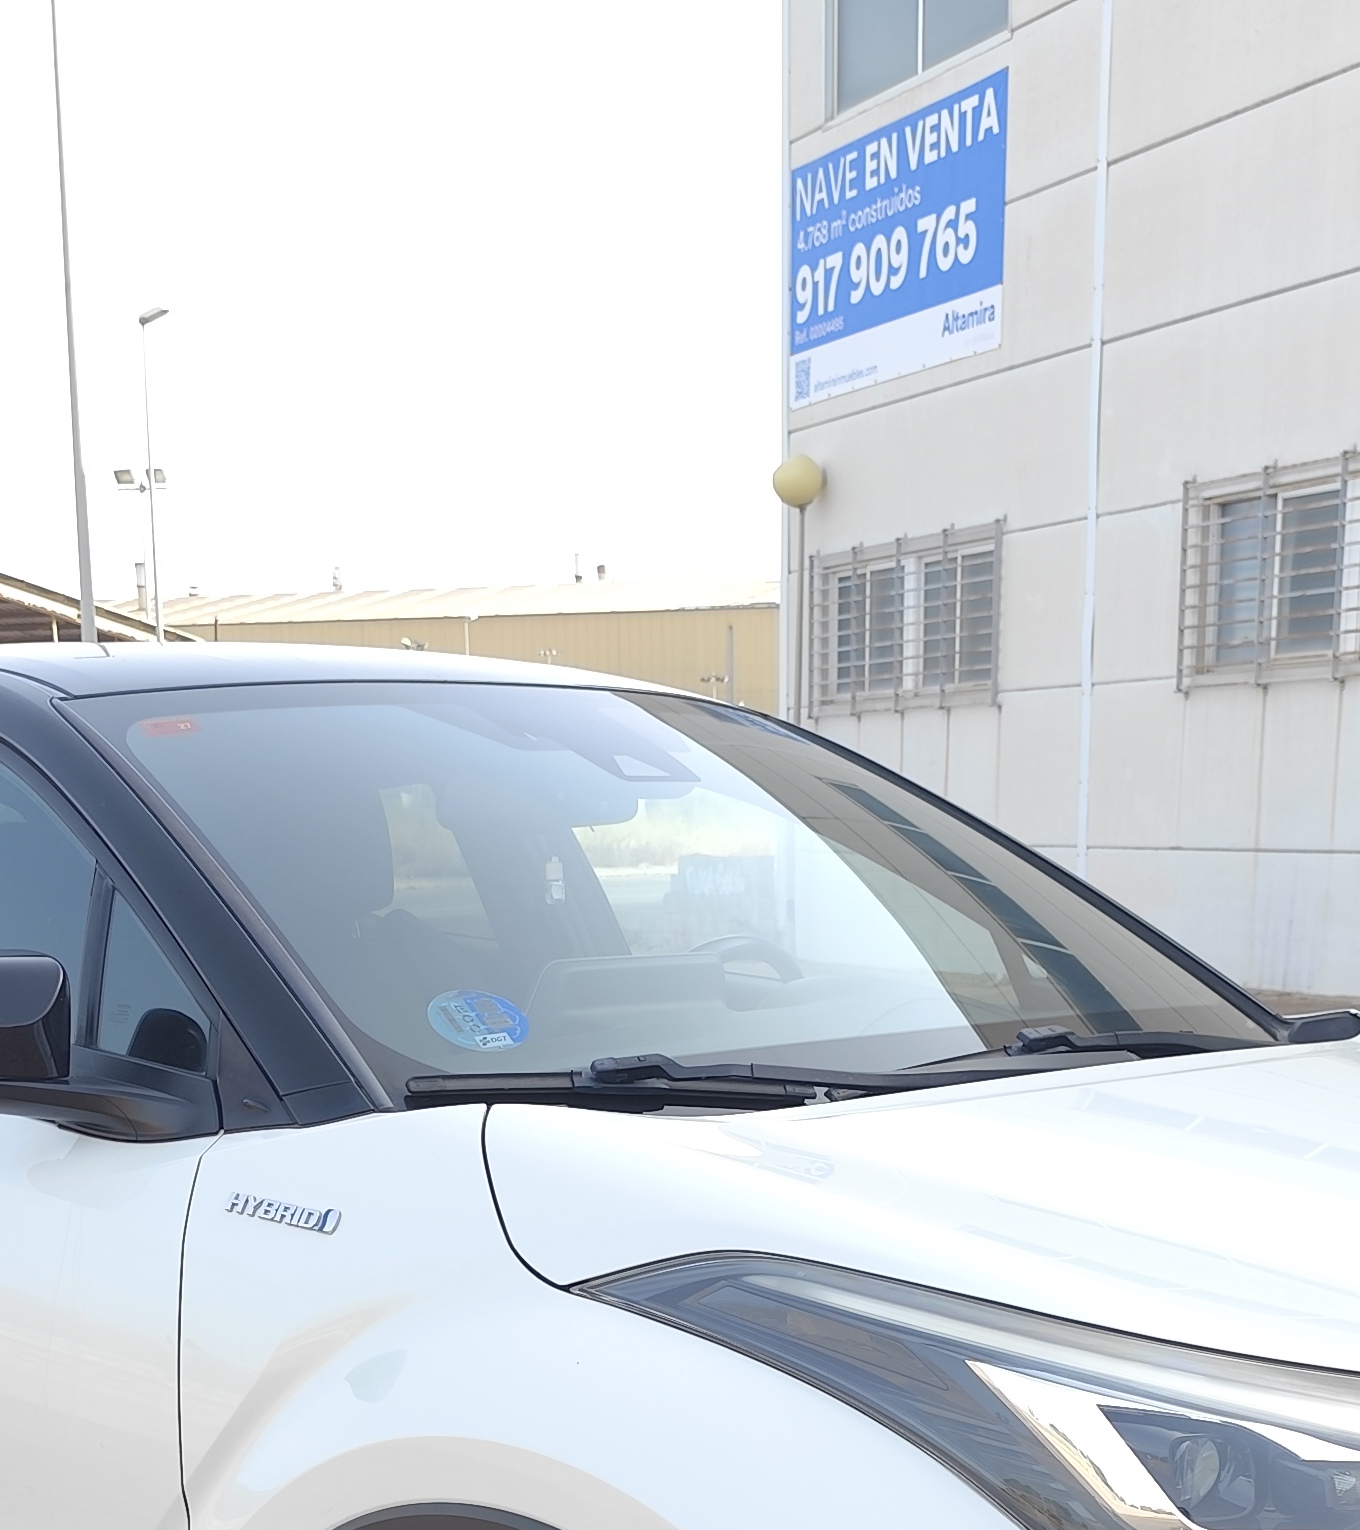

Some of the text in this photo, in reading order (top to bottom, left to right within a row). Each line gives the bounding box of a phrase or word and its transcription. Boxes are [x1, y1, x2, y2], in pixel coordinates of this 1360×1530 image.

[795, 87, 1000, 221] NAVE EN VENTA
[848, 183, 921, 232] construidos
[795, 198, 977, 324] 917 909 765
[941, 300, 995, 338] Altamira
[490, 1035, 507, 1043] DGT
[225, 1192, 323, 1232] HYBRID
